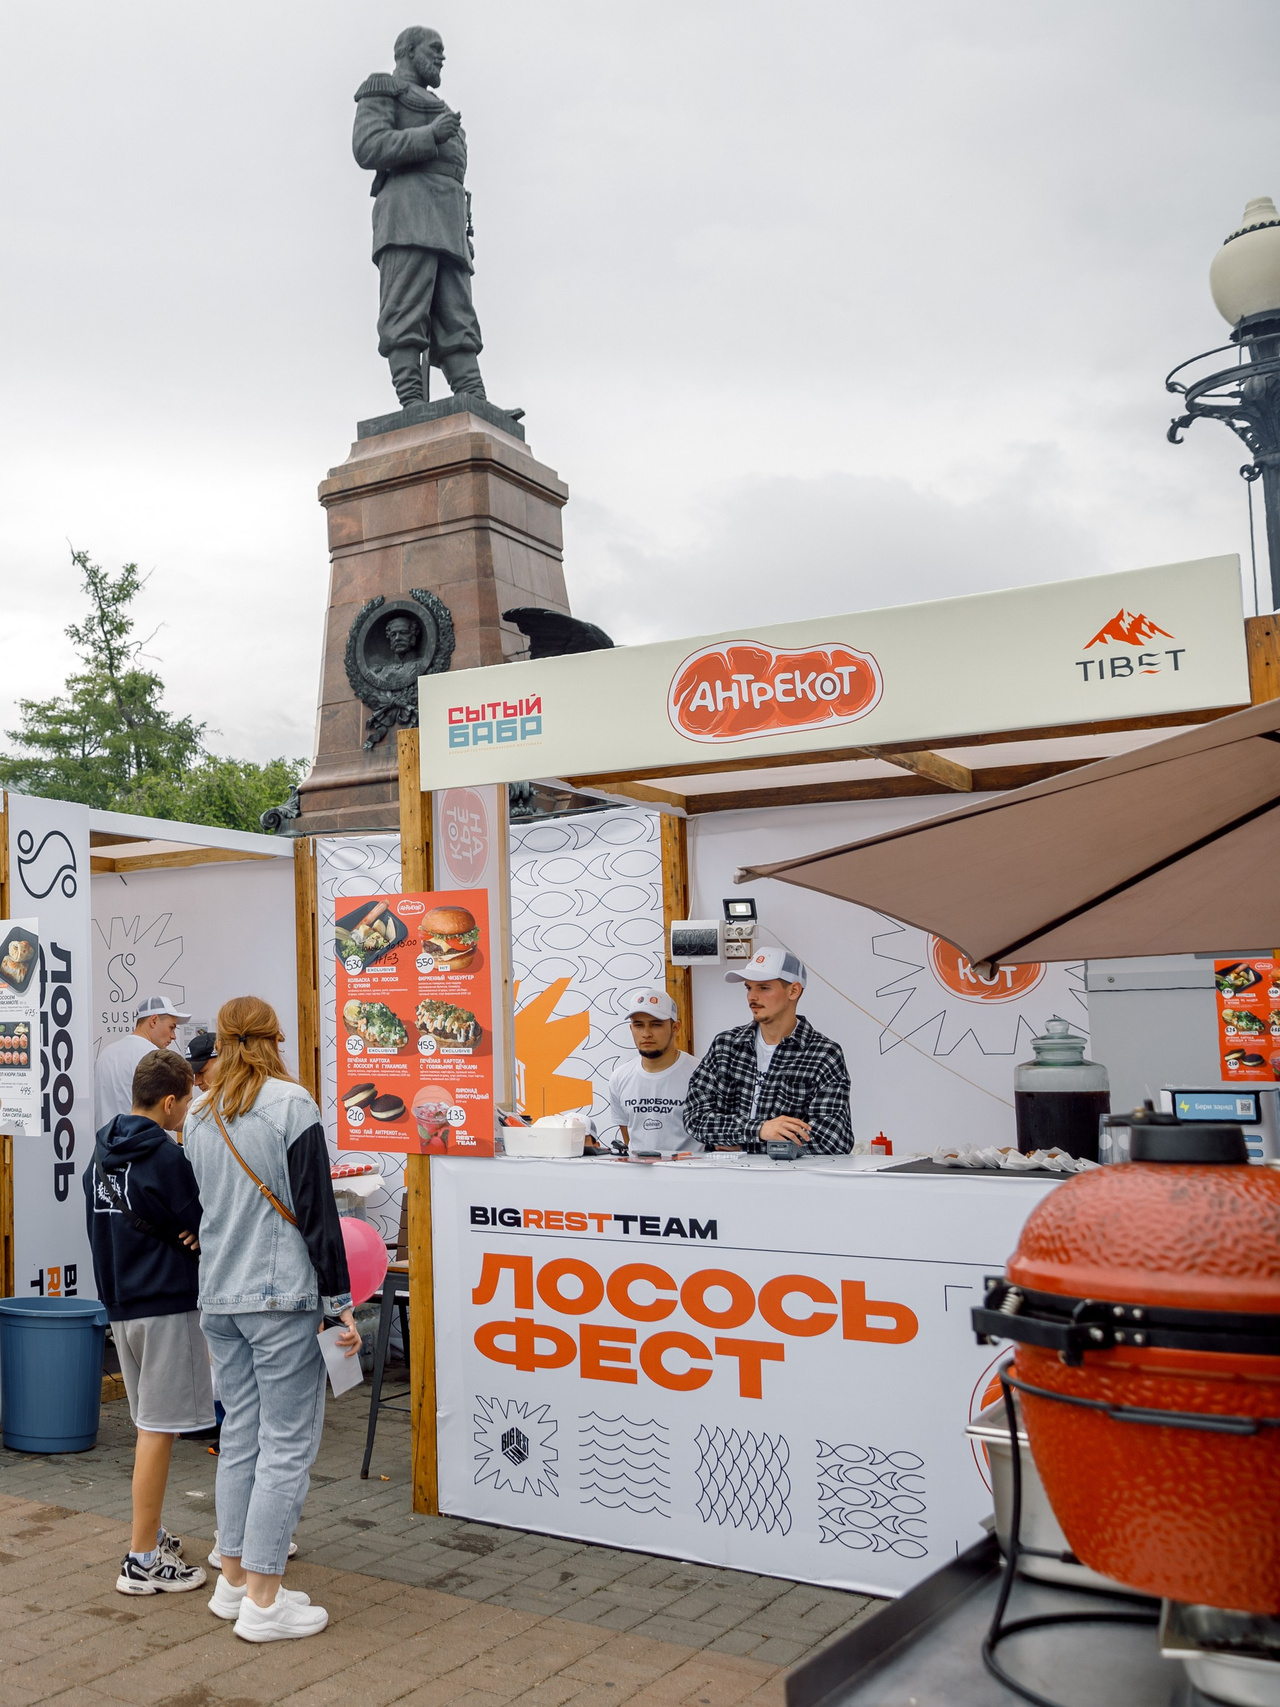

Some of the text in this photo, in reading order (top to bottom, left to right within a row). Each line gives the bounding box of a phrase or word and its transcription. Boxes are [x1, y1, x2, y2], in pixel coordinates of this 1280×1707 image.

[1075, 649, 1186, 682] TIBET
[688, 664, 858, 714] АНТРЕКОТ
[448, 693, 542, 725] СЫТЫЙ
[449, 715, 542, 748] БАБР
[346, 959, 362, 970] 530
[416, 957, 434, 968] 550
[347, 1039, 364, 1051] 525
[417, 1040, 435, 1050] 455
[50, 941, 77, 1203] ЛОСОСЬ
[455, 1092, 490, 1100] ВИНОГРАДНЫЙ
[624, 1097, 686, 1107] ПО ЛЮБОМУ
[633, 1105, 674, 1114] ПОВОДУ
[1194, 1102, 1212, 1111] Бери
[347, 1108, 365, 1122] 210
[447, 1109, 465, 1121] 135
[469, 1205, 719, 1241] BIGRESTTEAM
[471, 1252, 920, 1345] ЛОСОСЬ
[473, 1316, 786, 1400] ФЕСТ
